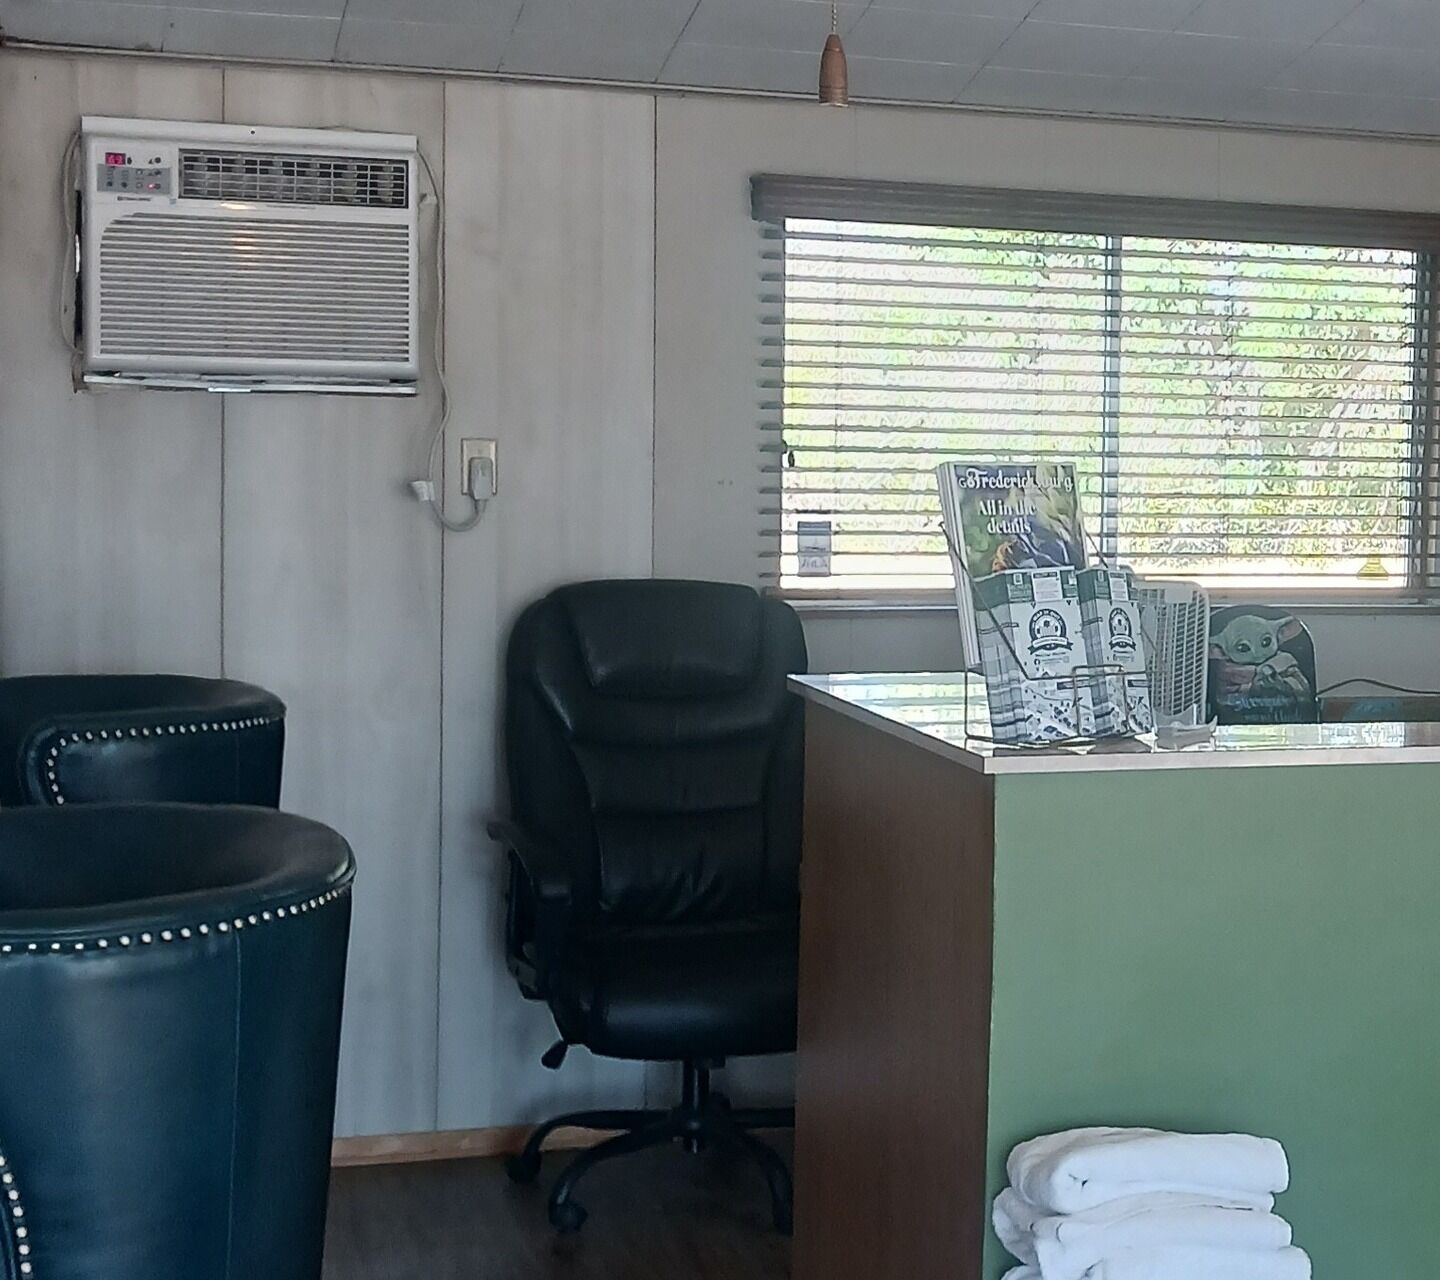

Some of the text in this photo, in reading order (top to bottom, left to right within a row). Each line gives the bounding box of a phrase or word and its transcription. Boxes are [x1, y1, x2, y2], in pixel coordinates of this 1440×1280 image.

[978, 499, 1037, 516] All in the
[987, 517, 1031, 534] details
